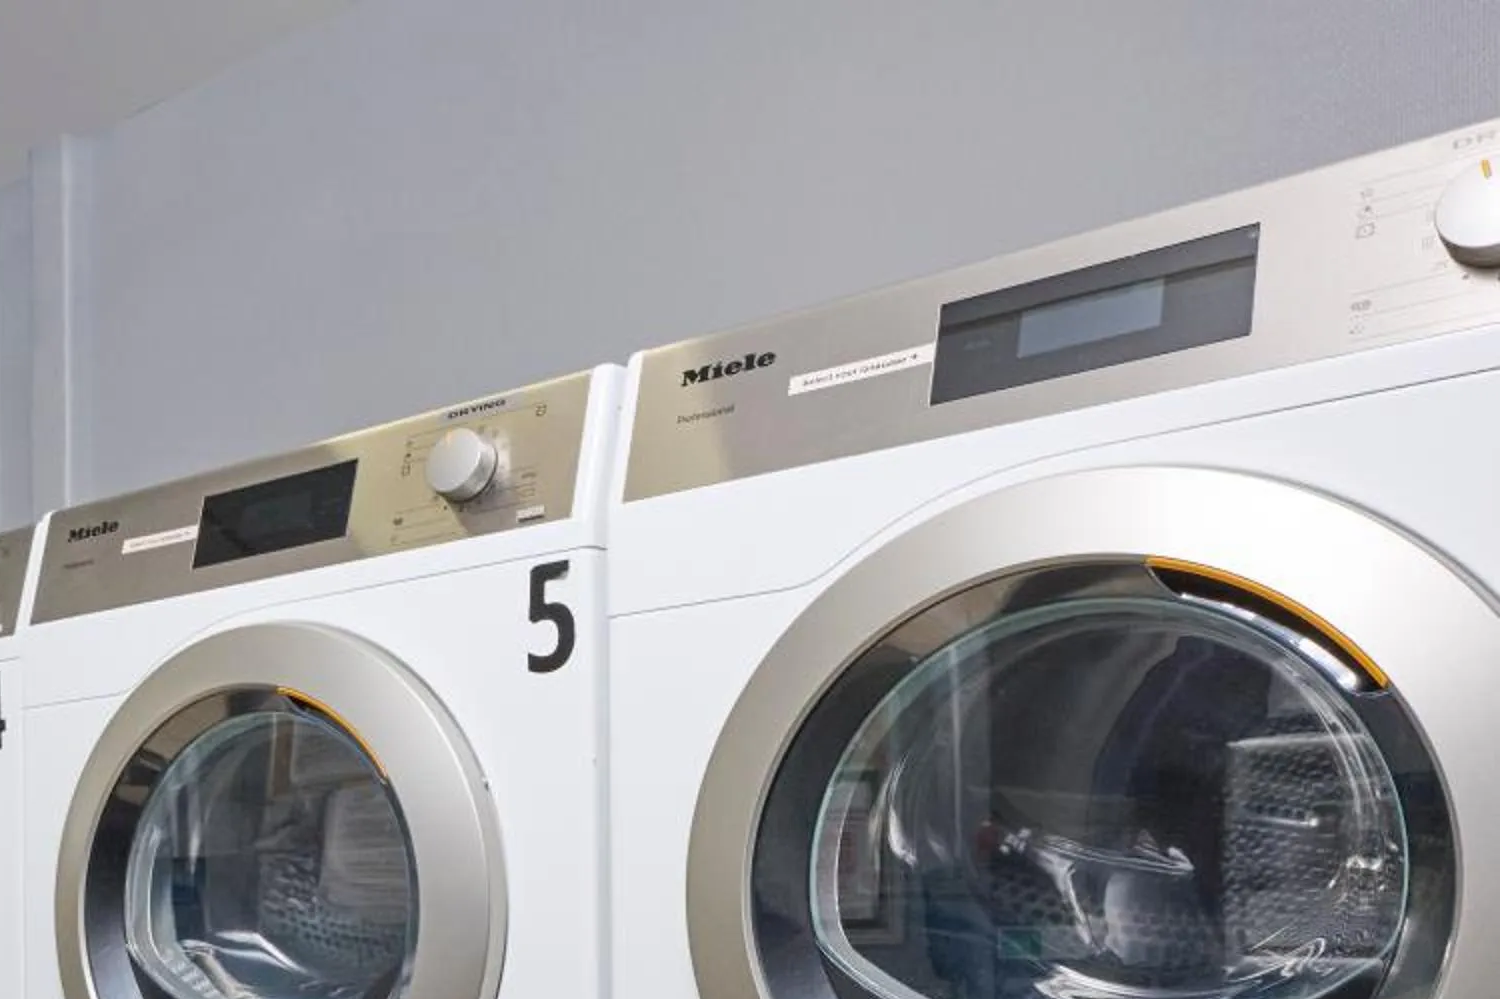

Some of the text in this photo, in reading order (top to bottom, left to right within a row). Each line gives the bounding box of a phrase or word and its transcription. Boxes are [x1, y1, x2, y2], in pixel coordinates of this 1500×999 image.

[681, 352, 777, 387] Miele
[68, 521, 119, 543] Miele
[528, 560, 575, 674] 5
